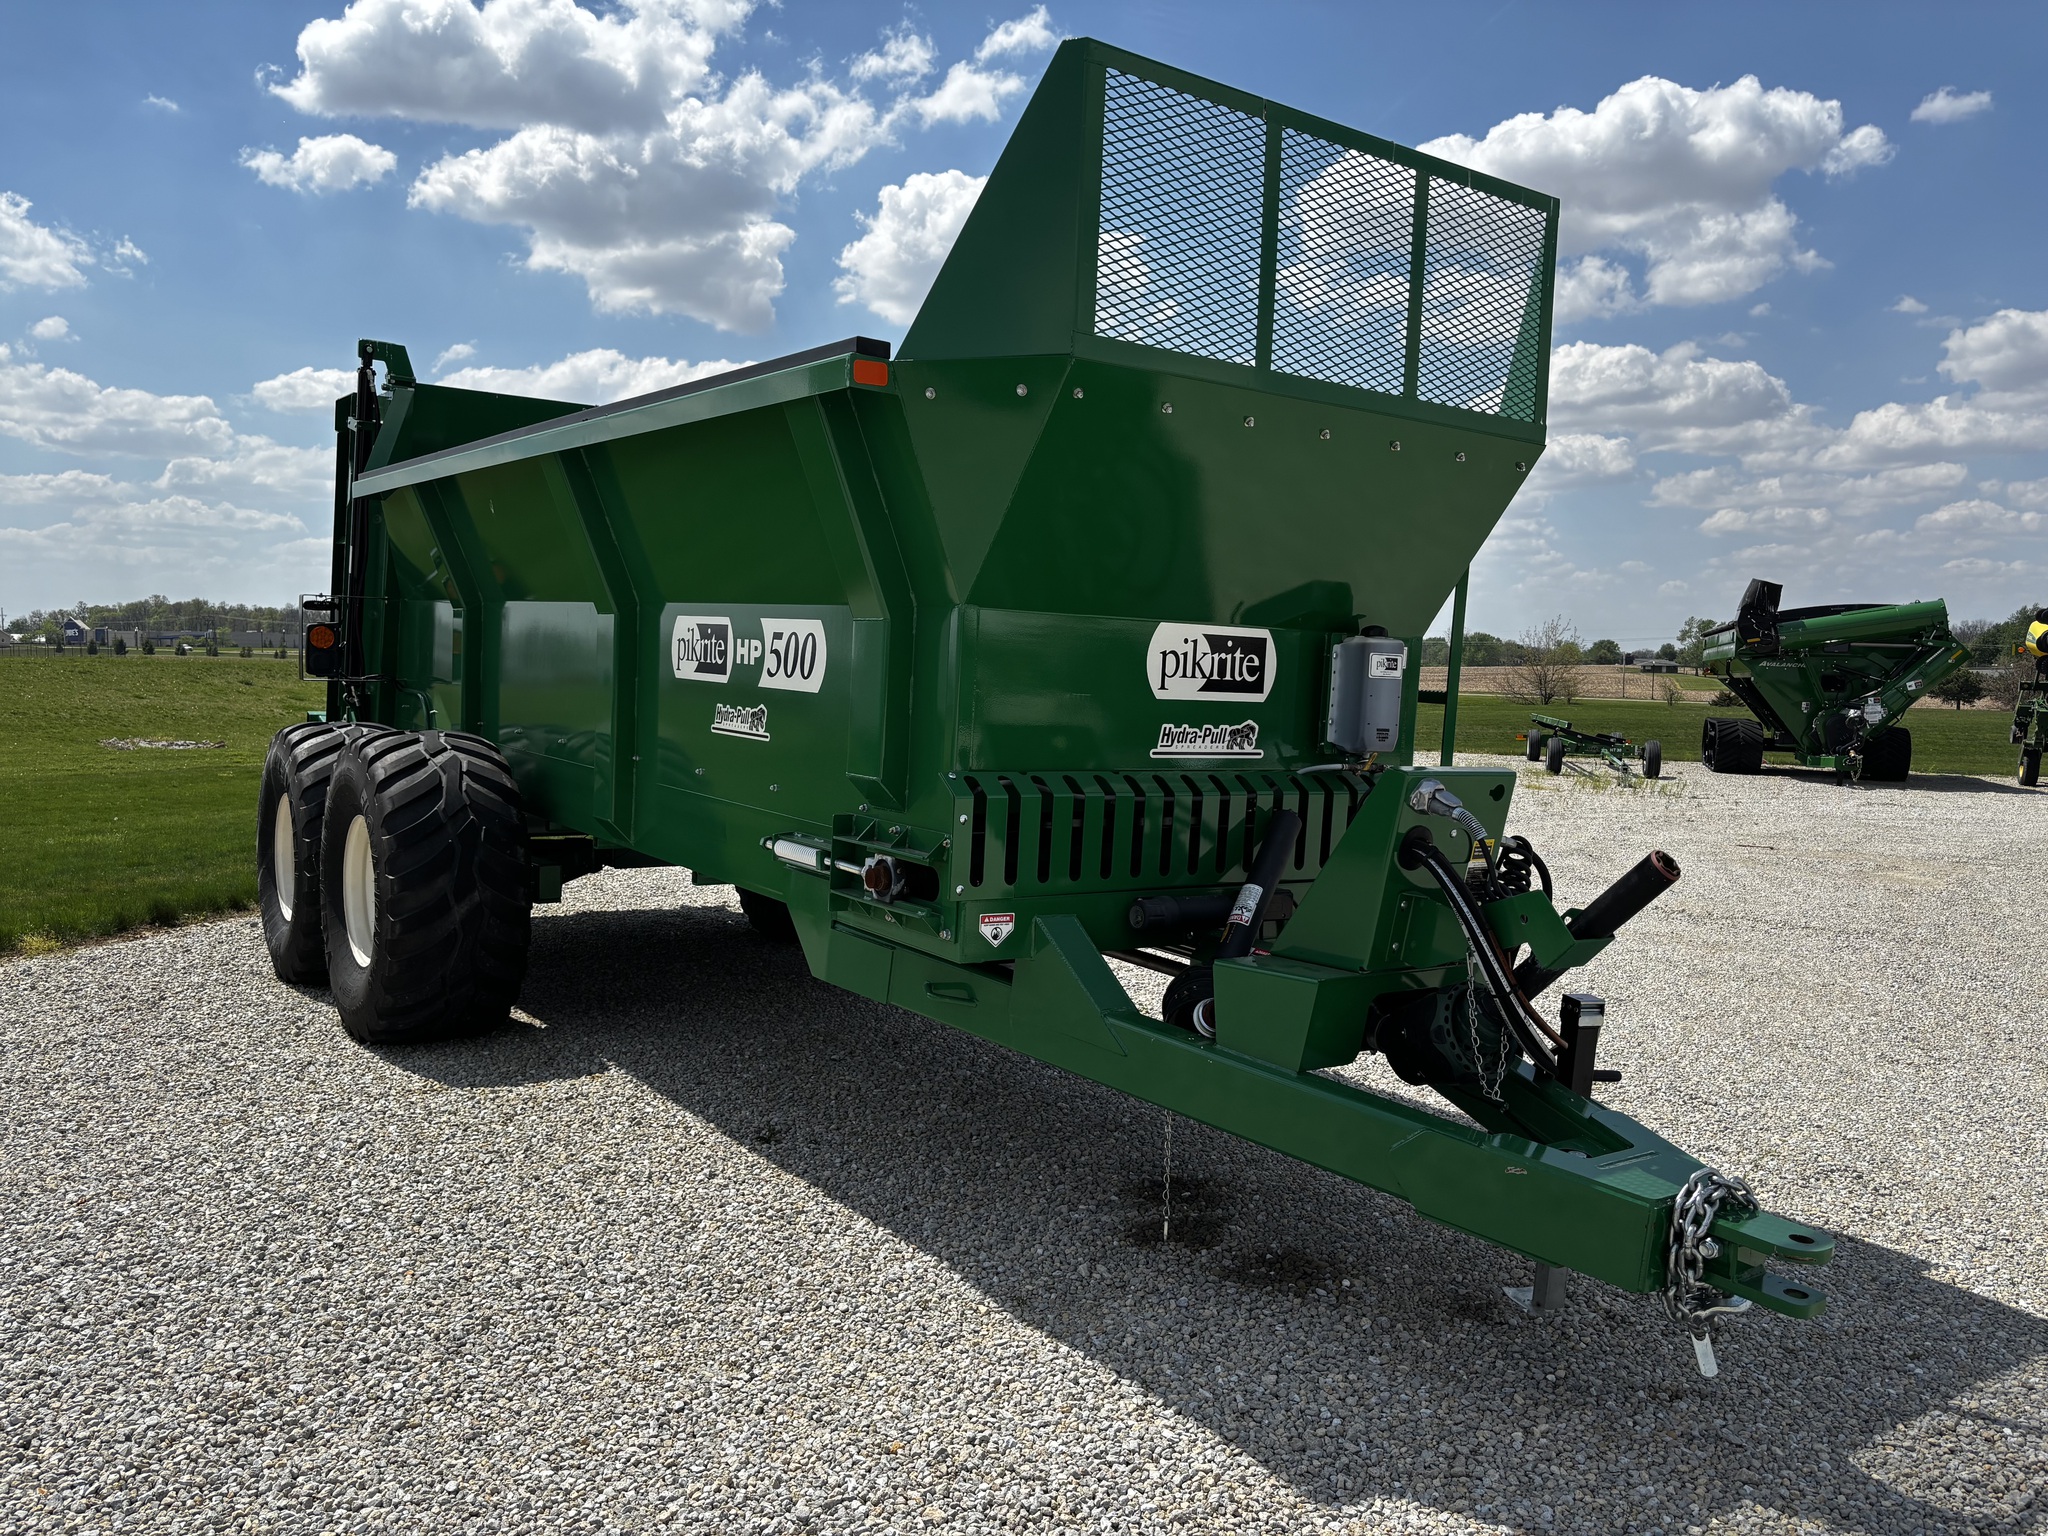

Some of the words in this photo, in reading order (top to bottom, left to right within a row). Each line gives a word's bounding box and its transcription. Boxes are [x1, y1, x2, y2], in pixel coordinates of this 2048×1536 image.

[676, 627, 725, 671] pikrite
[736, 638, 763, 666] HP
[766, 631, 817, 680] 500
[1157, 637, 1260, 691] pikrite
[715, 705, 751, 725] Hydra-Pull
[1159, 726, 1228, 748] Hydra-Pull
